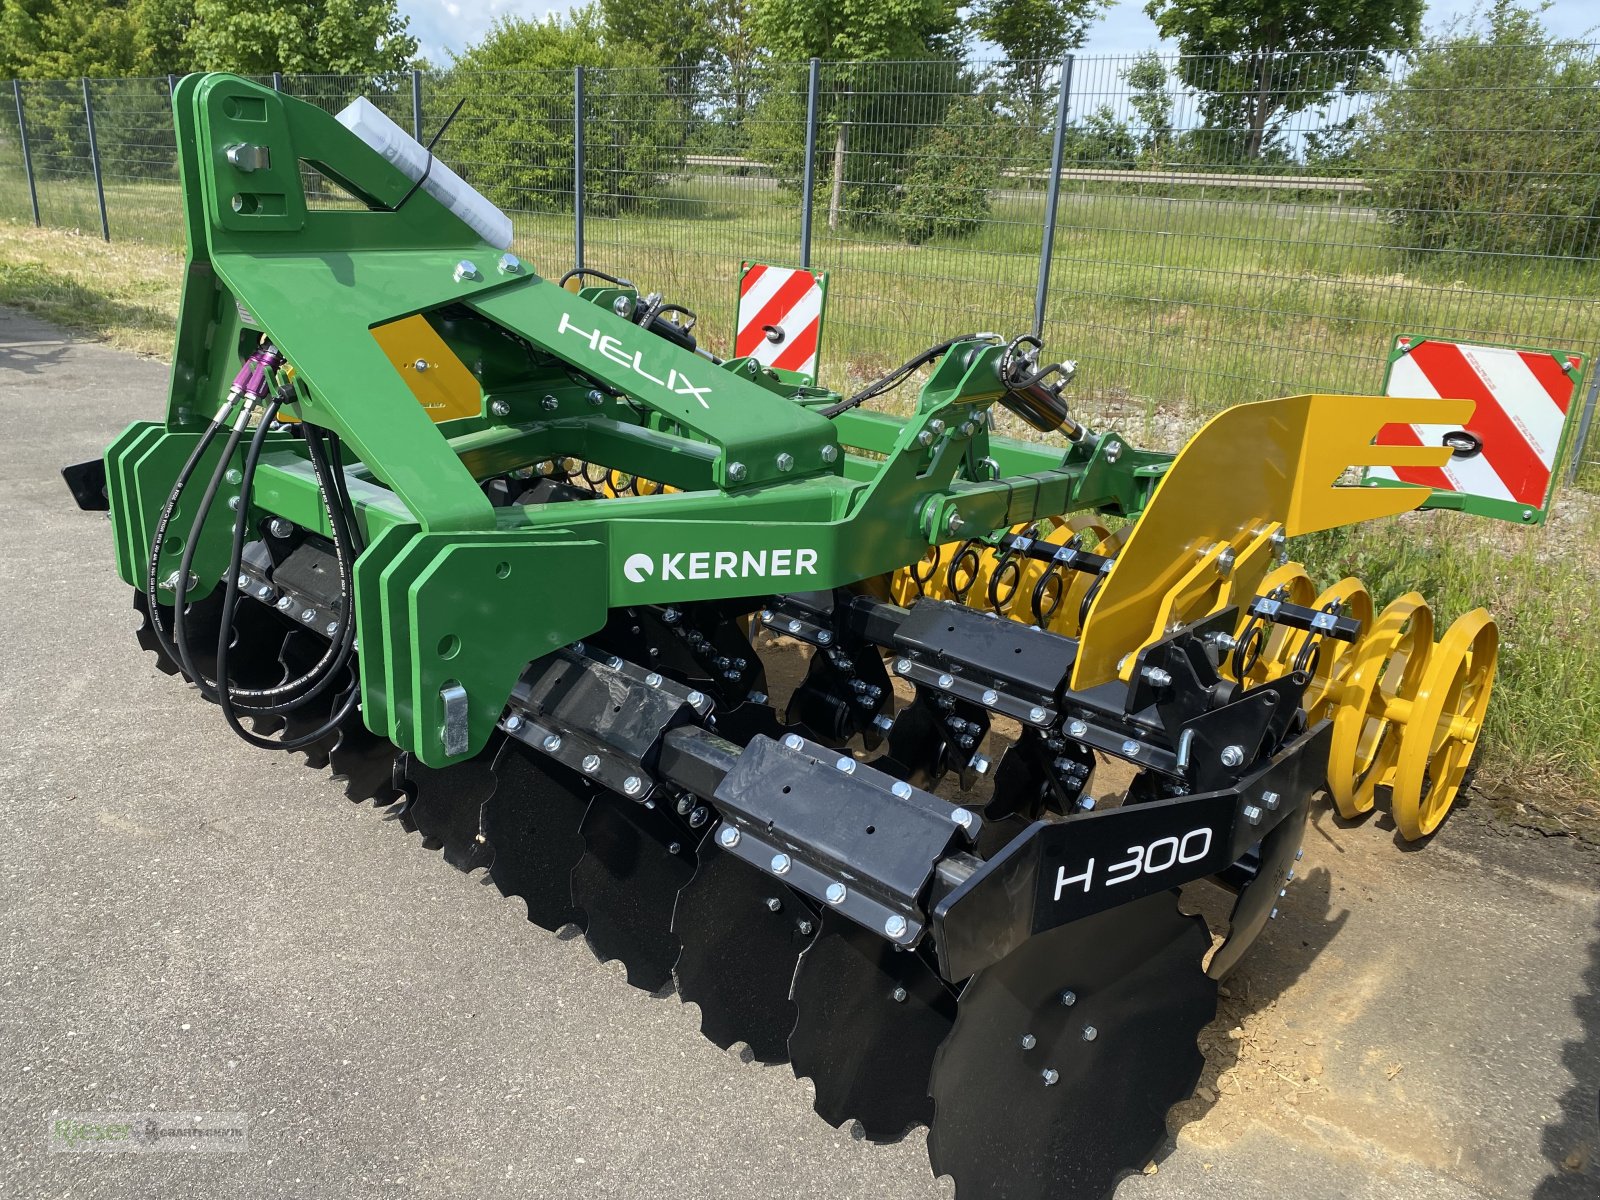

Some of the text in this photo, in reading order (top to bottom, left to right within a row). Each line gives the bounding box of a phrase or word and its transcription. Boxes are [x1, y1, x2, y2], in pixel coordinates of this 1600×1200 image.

[557, 312, 713, 410] HELIX
[661, 548, 819, 581] KERNER
[1053, 857, 1095, 902] H
[1105, 827, 1213, 887] 300
